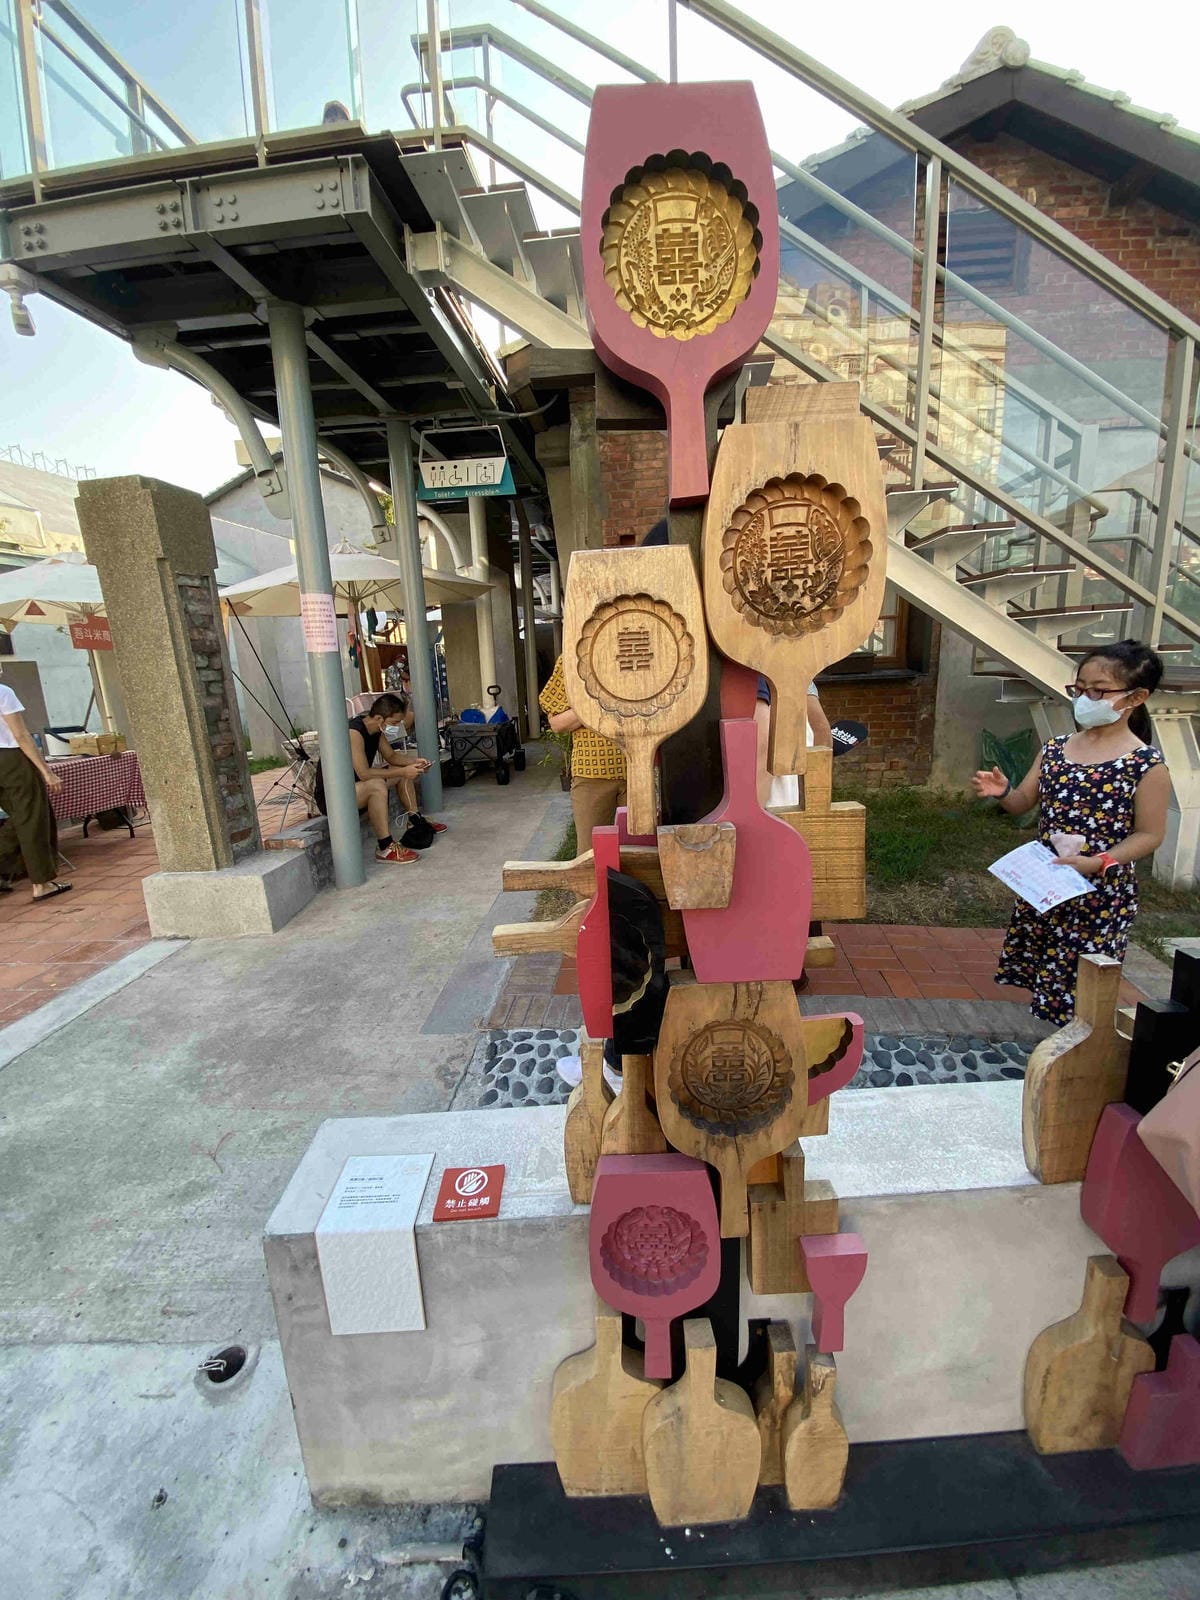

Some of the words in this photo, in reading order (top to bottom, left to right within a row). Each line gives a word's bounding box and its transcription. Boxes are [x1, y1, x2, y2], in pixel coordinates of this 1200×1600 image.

[465, 489, 494, 497] Accessible
[444, 1196, 490, 1208] 禁止碰觸
